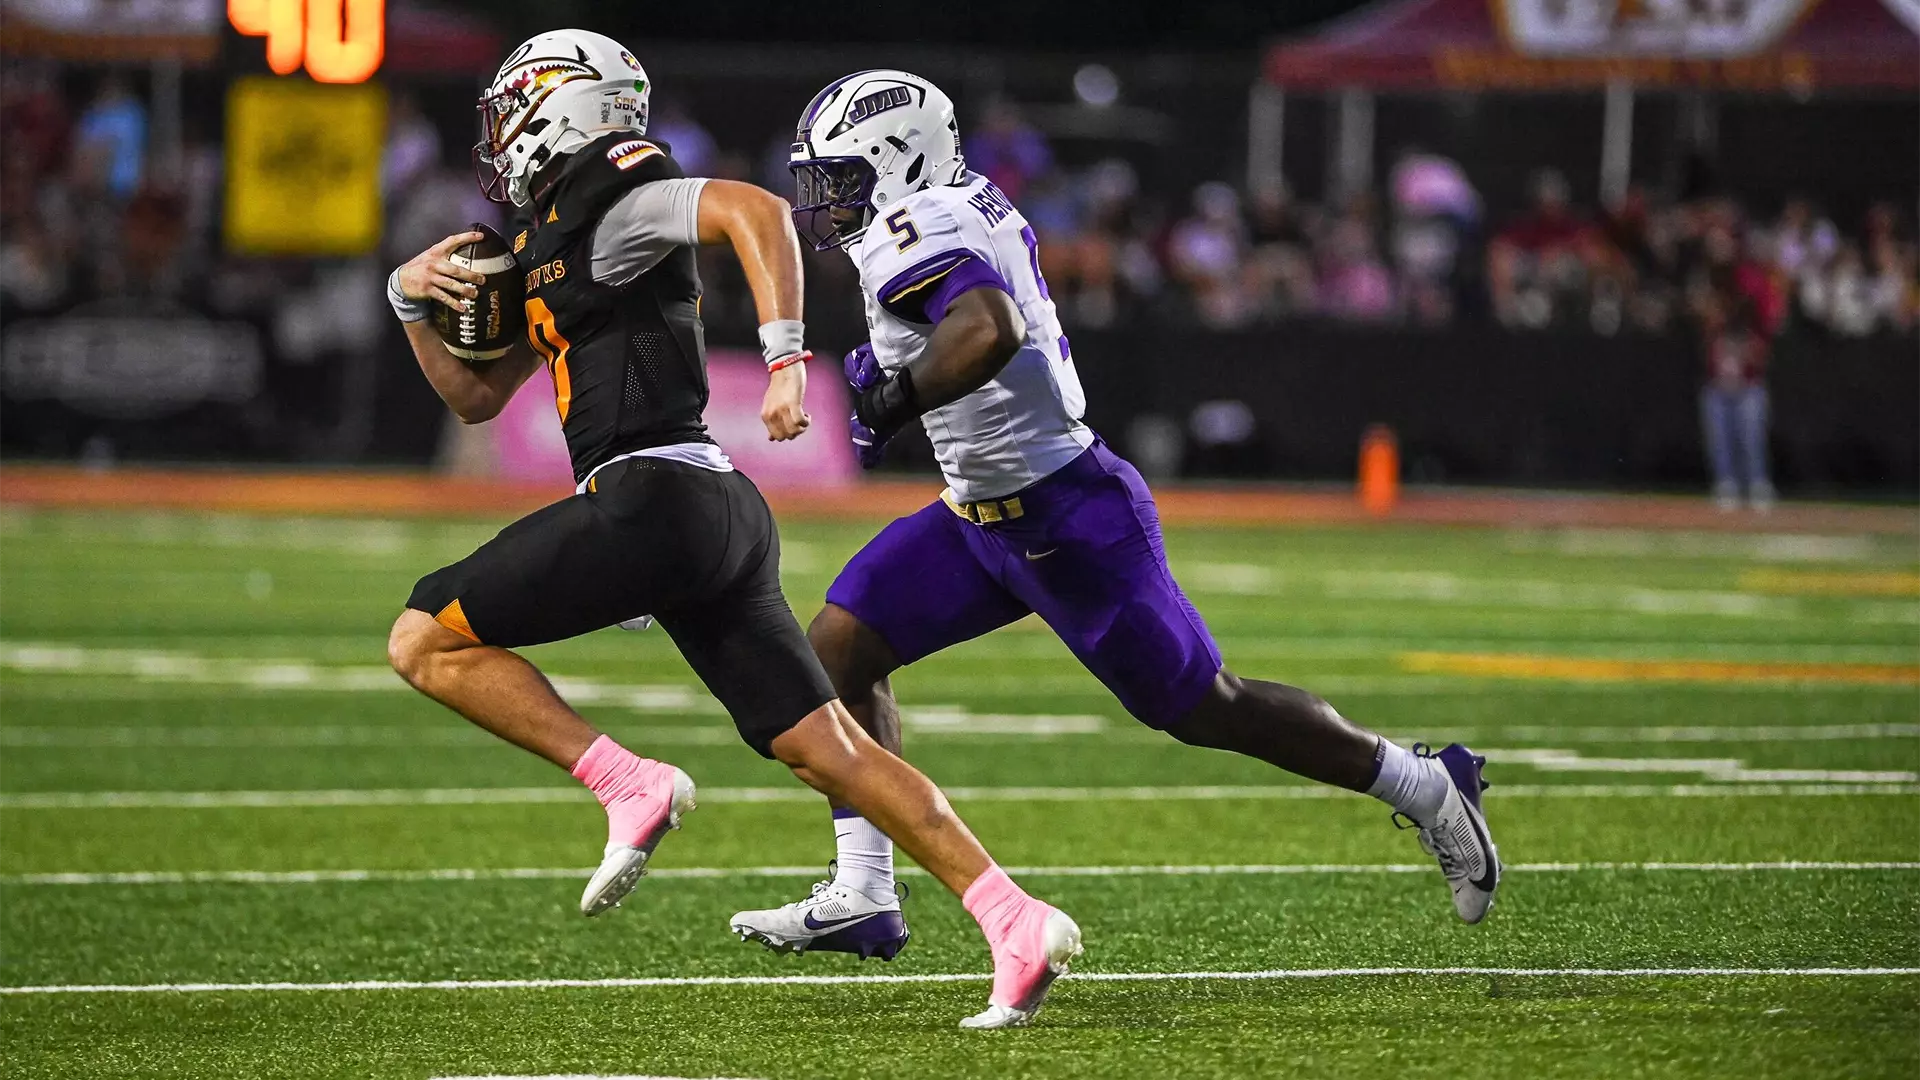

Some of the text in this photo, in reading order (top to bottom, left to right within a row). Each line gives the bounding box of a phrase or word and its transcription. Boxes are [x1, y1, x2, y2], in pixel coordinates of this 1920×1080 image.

[614, 95, 637, 112] SBC
[848, 86, 912, 125] JMU
[883, 205, 922, 255] 5
